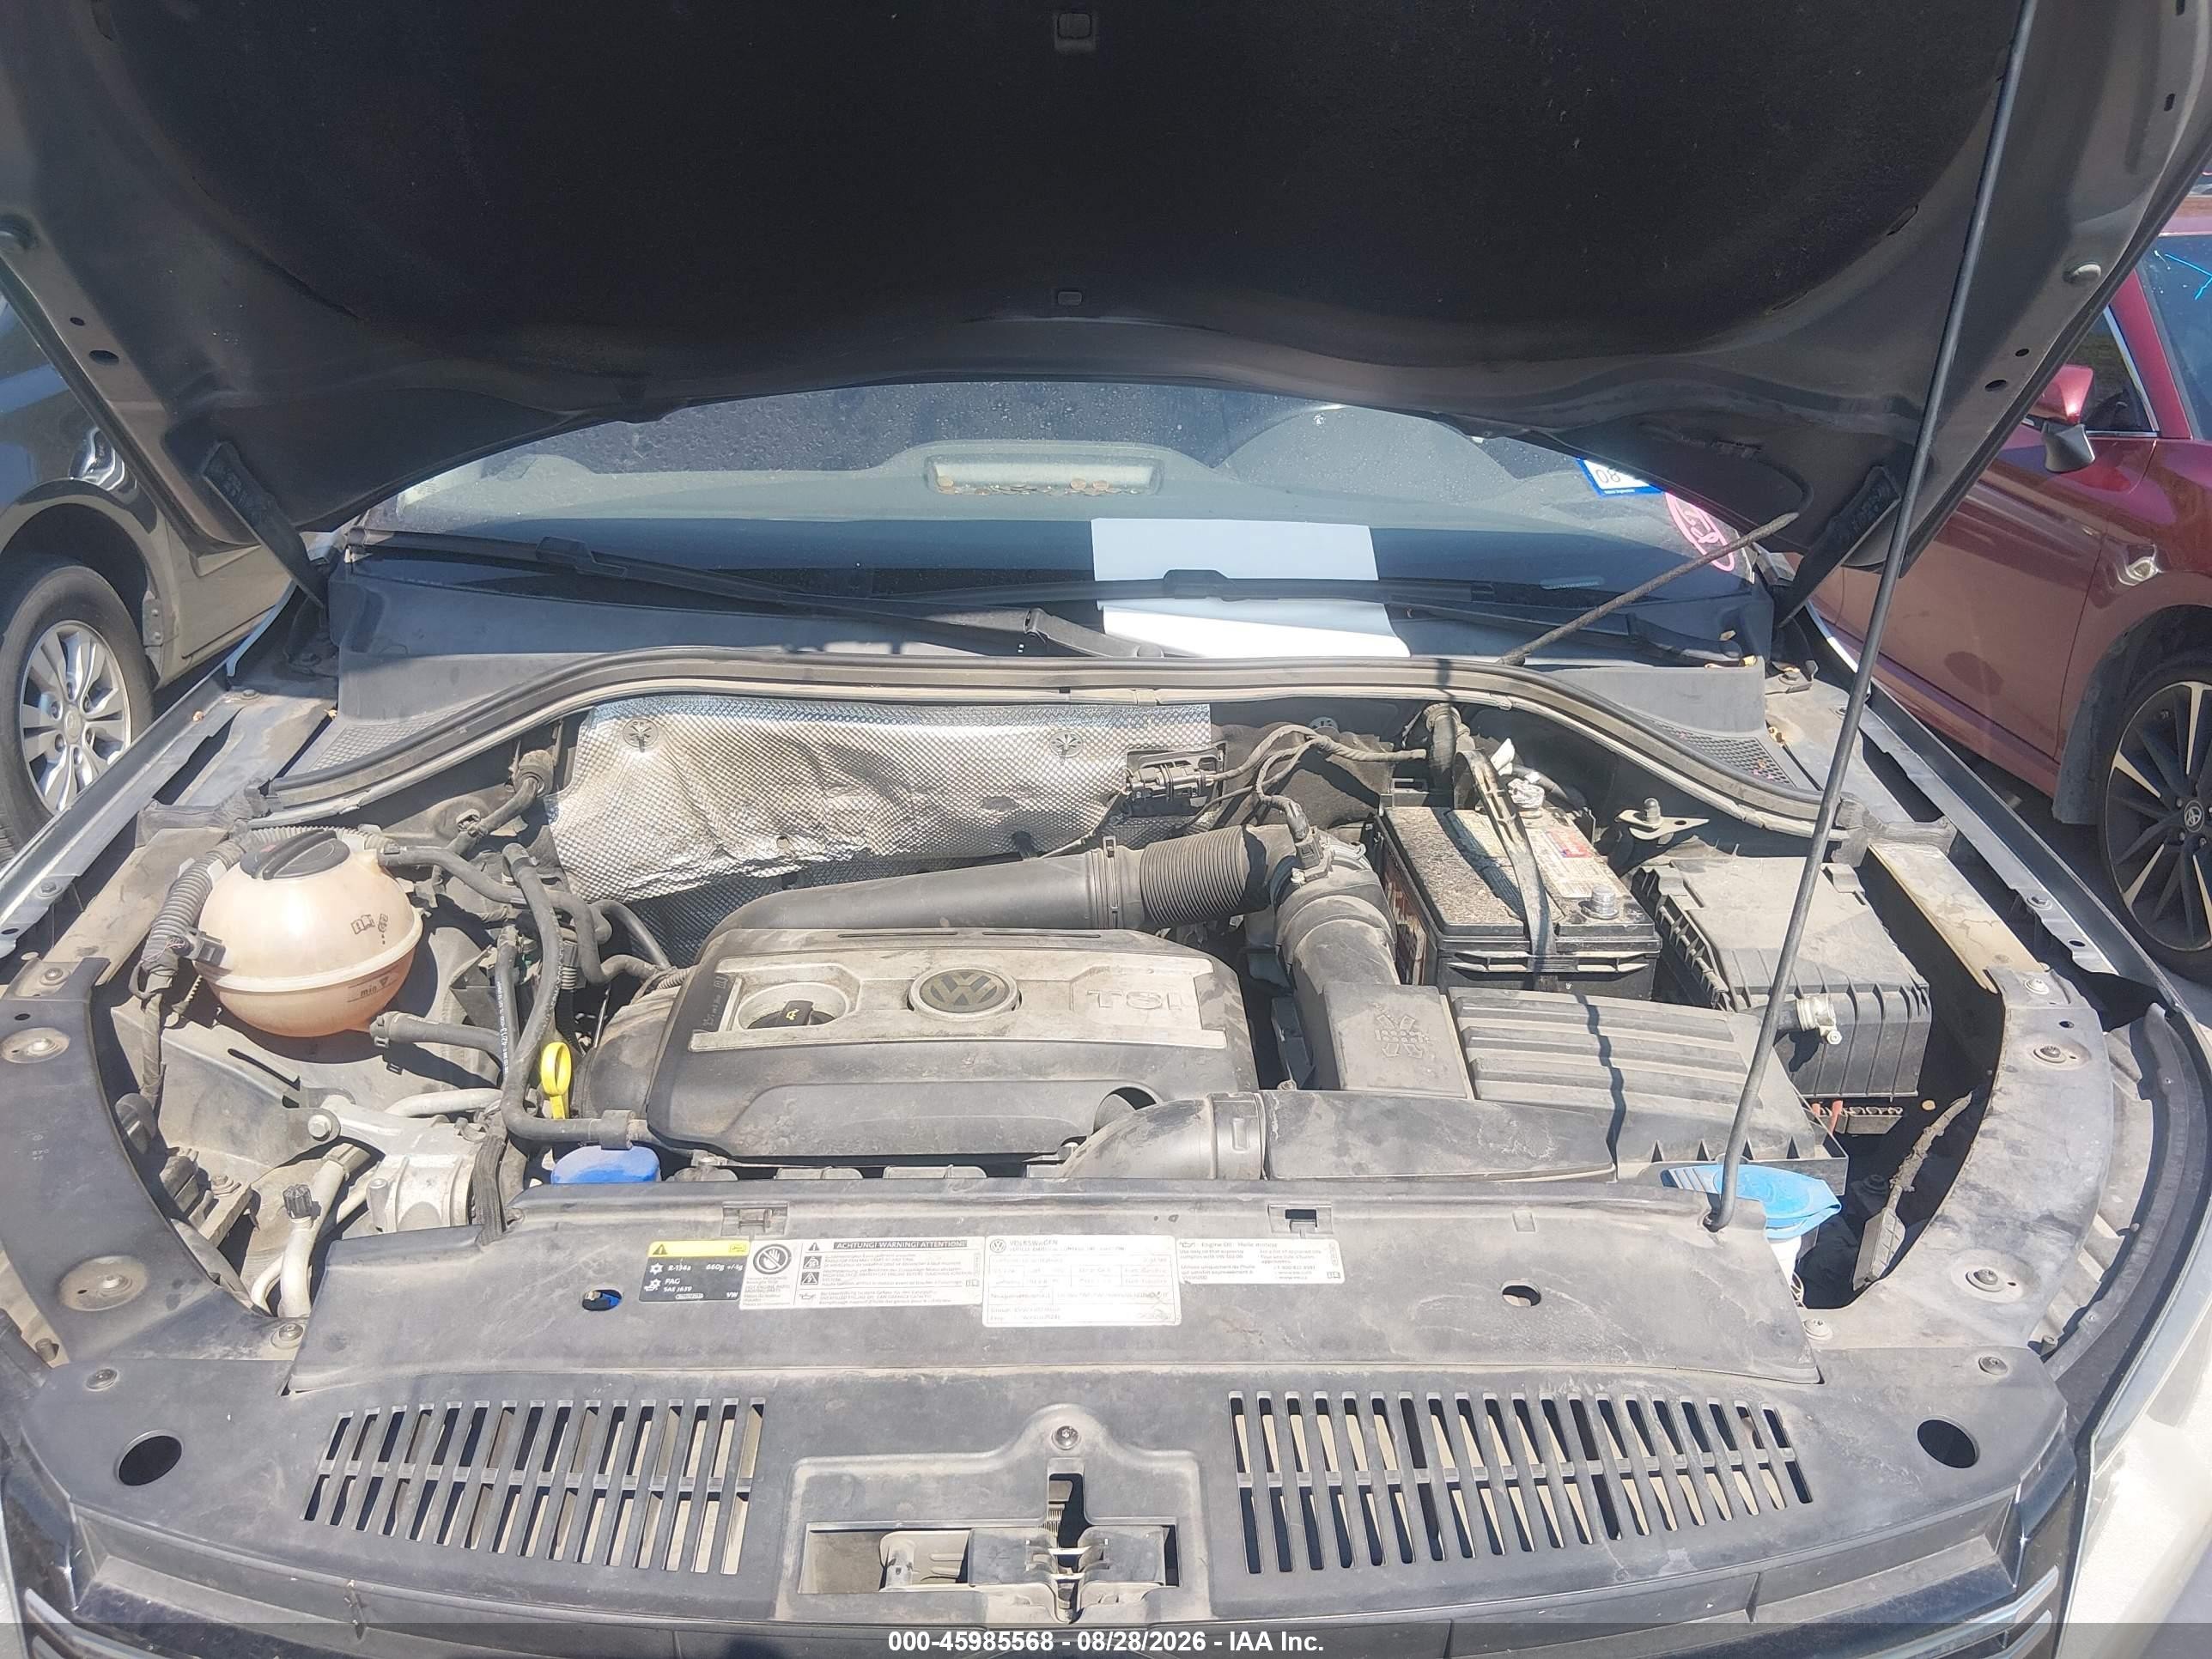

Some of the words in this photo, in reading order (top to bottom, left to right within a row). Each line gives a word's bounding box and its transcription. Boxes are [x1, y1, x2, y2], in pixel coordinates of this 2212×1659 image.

[361, 985, 377, 997] min
[1087, 989, 1182, 1011] TSI
[667, 1262, 692, 1271] R-134a
[706, 1263, 725, 1272] 660g
